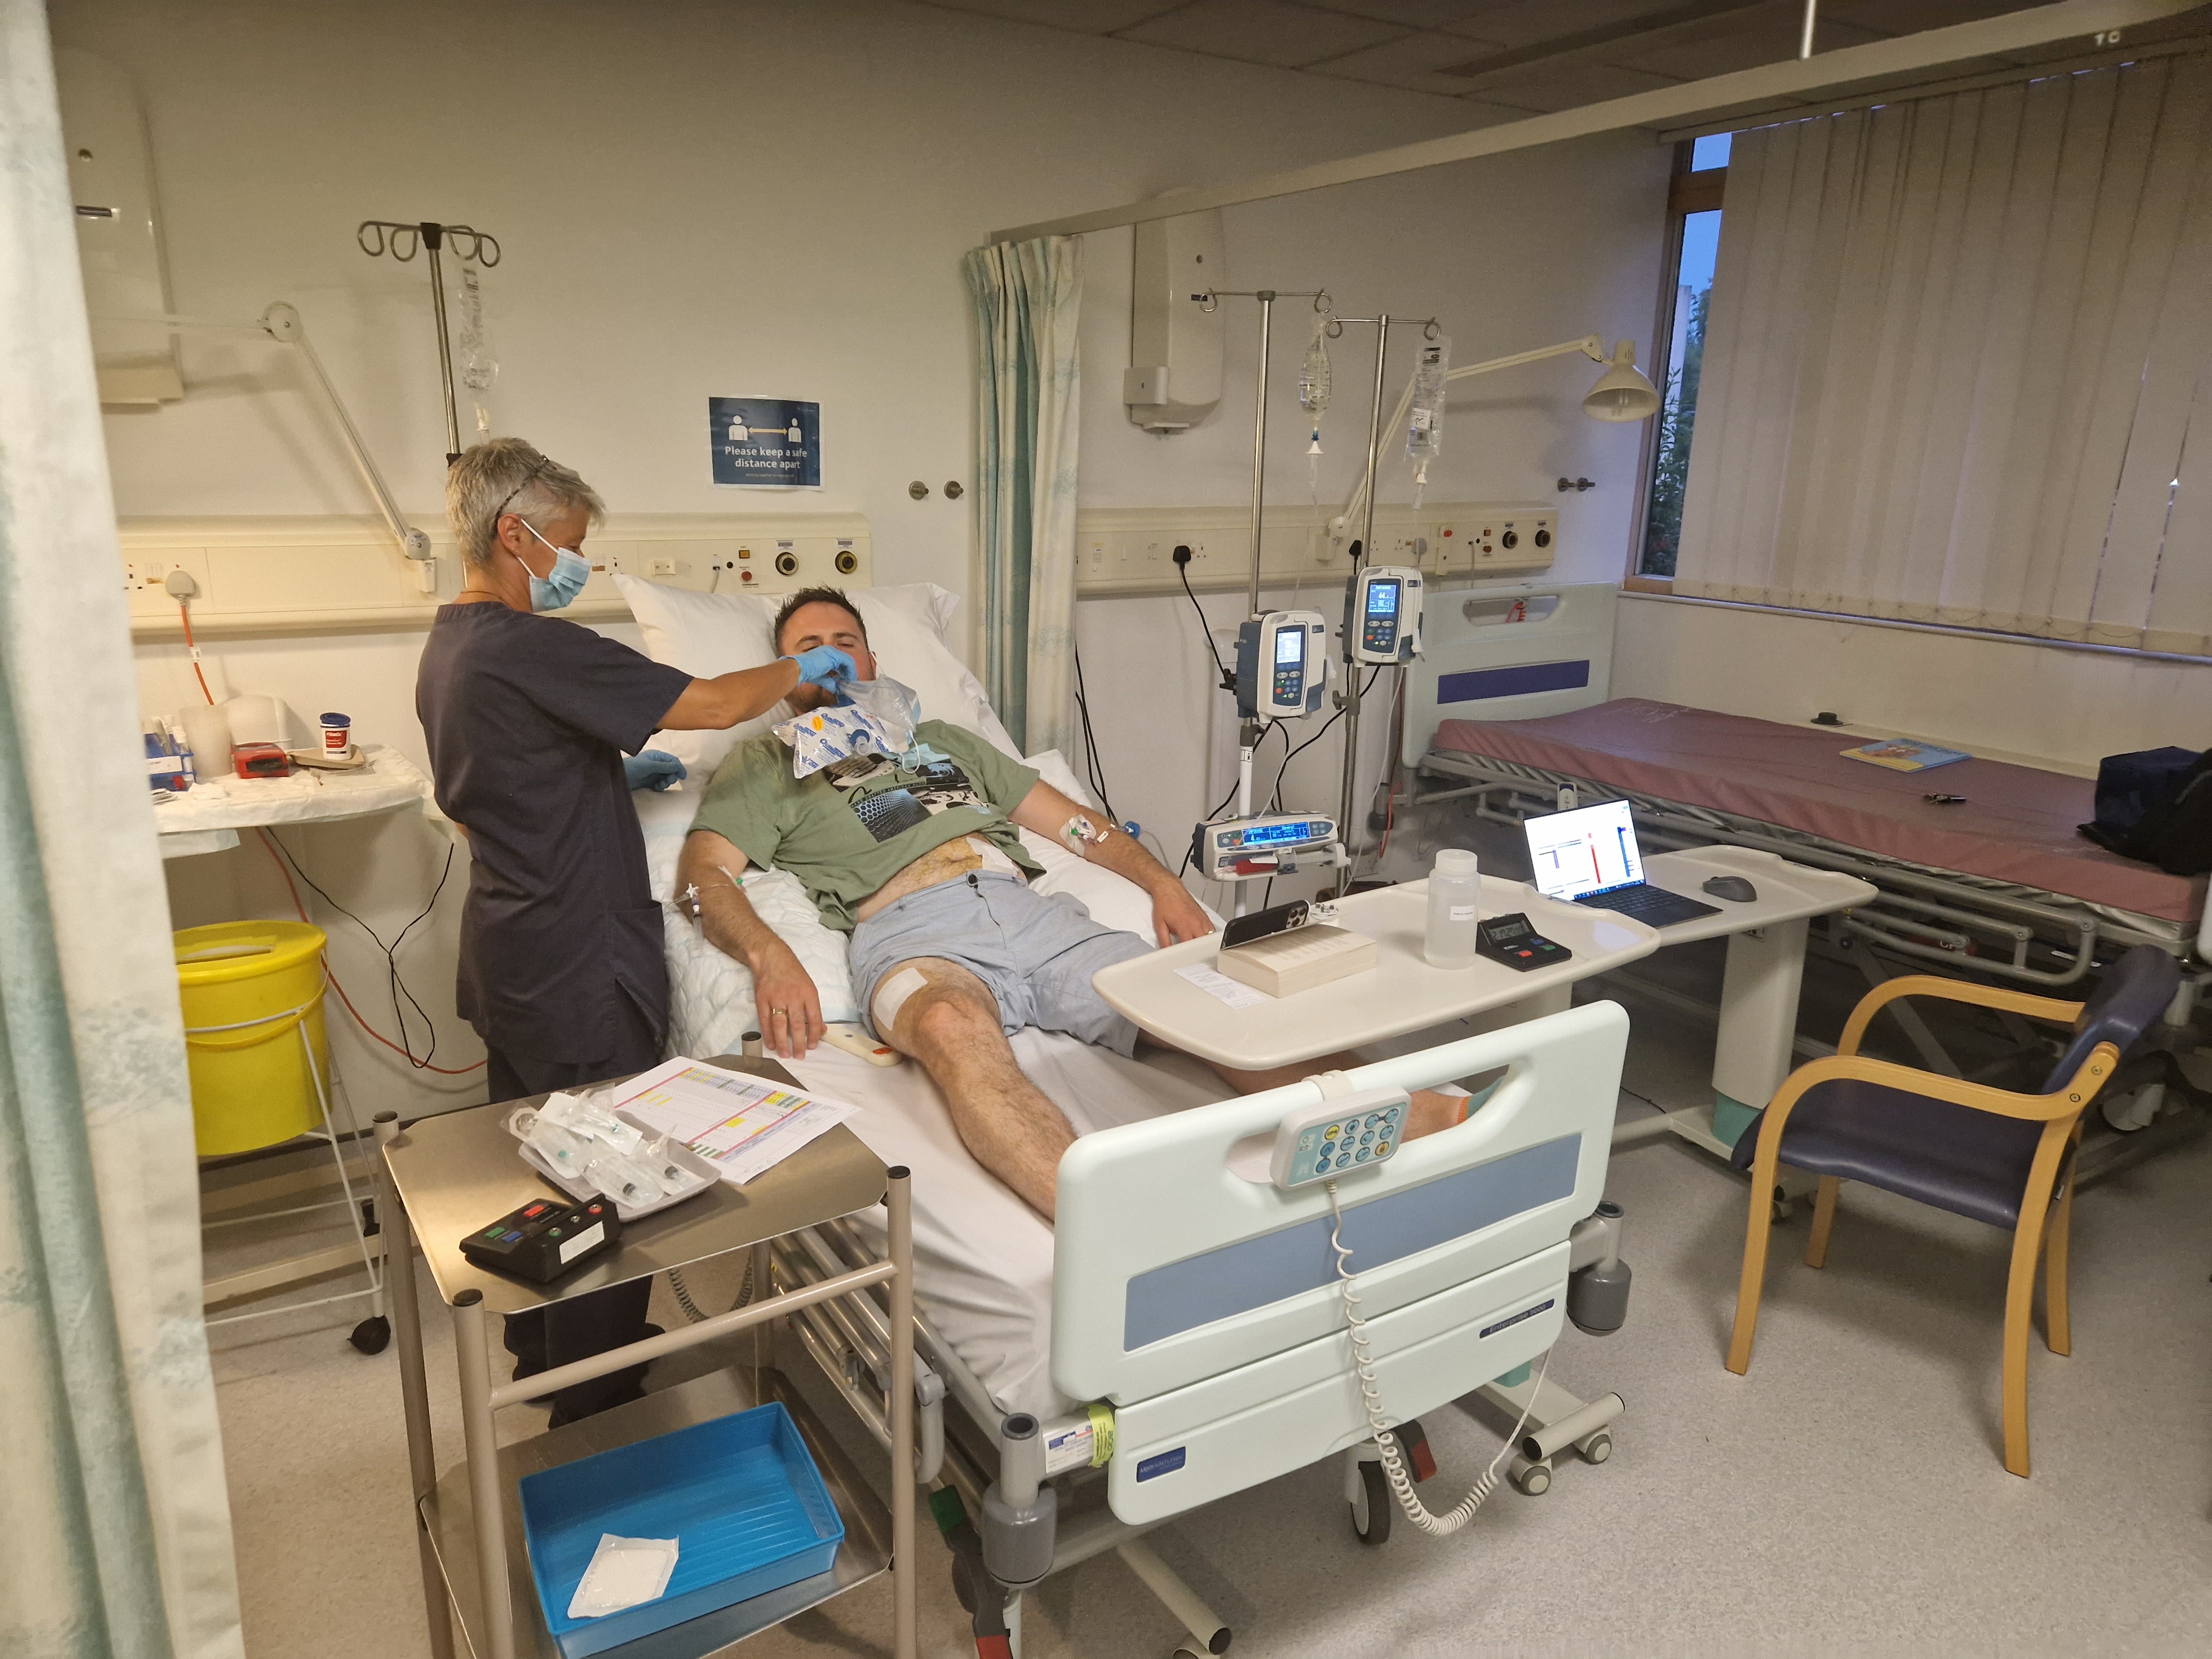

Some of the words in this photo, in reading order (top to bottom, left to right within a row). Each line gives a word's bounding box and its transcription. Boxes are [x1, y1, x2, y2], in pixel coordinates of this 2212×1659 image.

[725, 446, 757, 456] Please
[760, 447, 783, 458] keep
[792, 448, 807, 457] safe
[735, 458, 777, 468] distance
[780, 461, 800, 470] apart
[865, 789, 885, 800] CRAFTED
[1490, 1312, 1528, 1333] Enterprise
